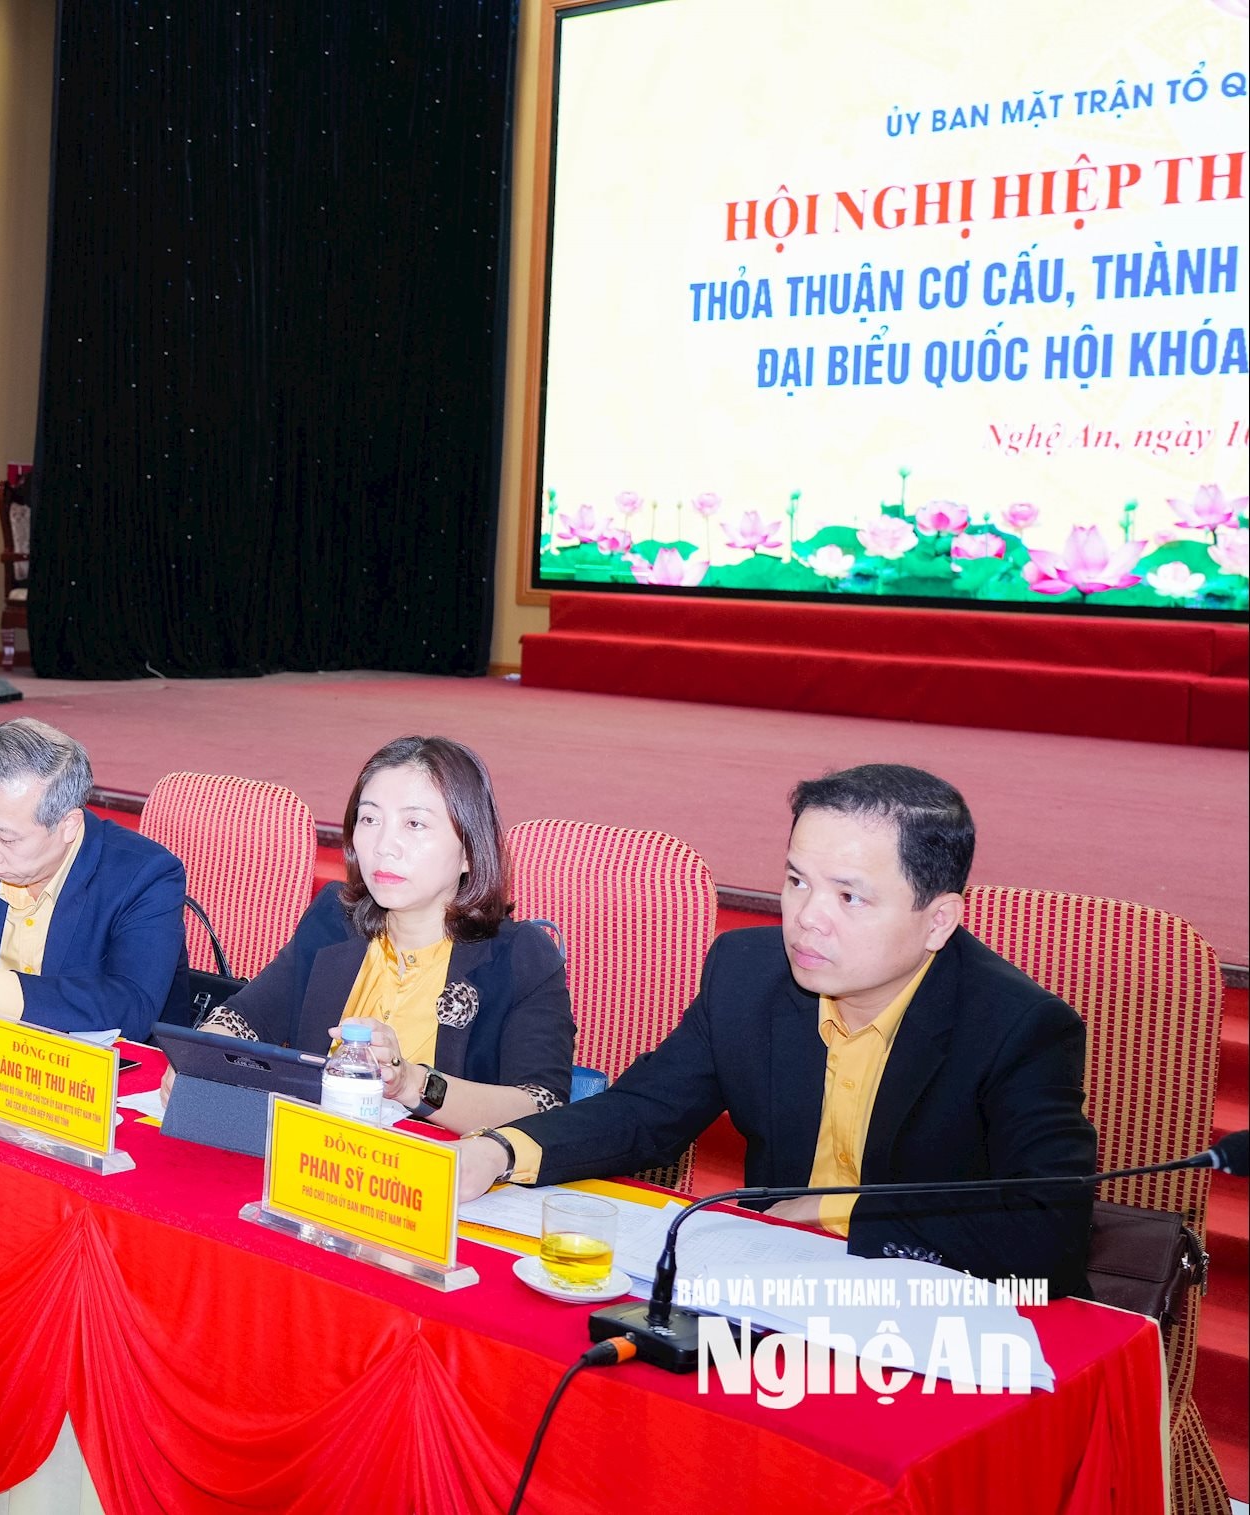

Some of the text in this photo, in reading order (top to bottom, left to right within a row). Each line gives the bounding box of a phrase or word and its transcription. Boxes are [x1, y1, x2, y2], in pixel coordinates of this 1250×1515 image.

[887, 61, 1247, 137] ỦY BAN MẶT TRẬN TỔ Q
[727, 152, 1245, 253] HỘI NGHỊ HIỆP TH
[690, 241, 1238, 327] THỎA THUẬN CƠ CẤU, THÀNH
[757, 318, 1248, 396] ĐẠI BIỂU QUỐC HỘI KHÓA
[982, 422, 1062, 456] Nghệ
[1067, 424, 1121, 450] An,
[1134, 420, 1211, 456] ngày
[12, 1039, 70, 1068] ĐỒNG CHÍ
[25, 1066, 42, 1090] THỊ
[45, 1072, 65, 1093] THU
[68, 1078, 95, 1103] HIỀN
[323, 1133, 400, 1169] ĐỒNG CHÍ
[299, 1152, 423, 1211] PHAN SỸ CƯỜNG
